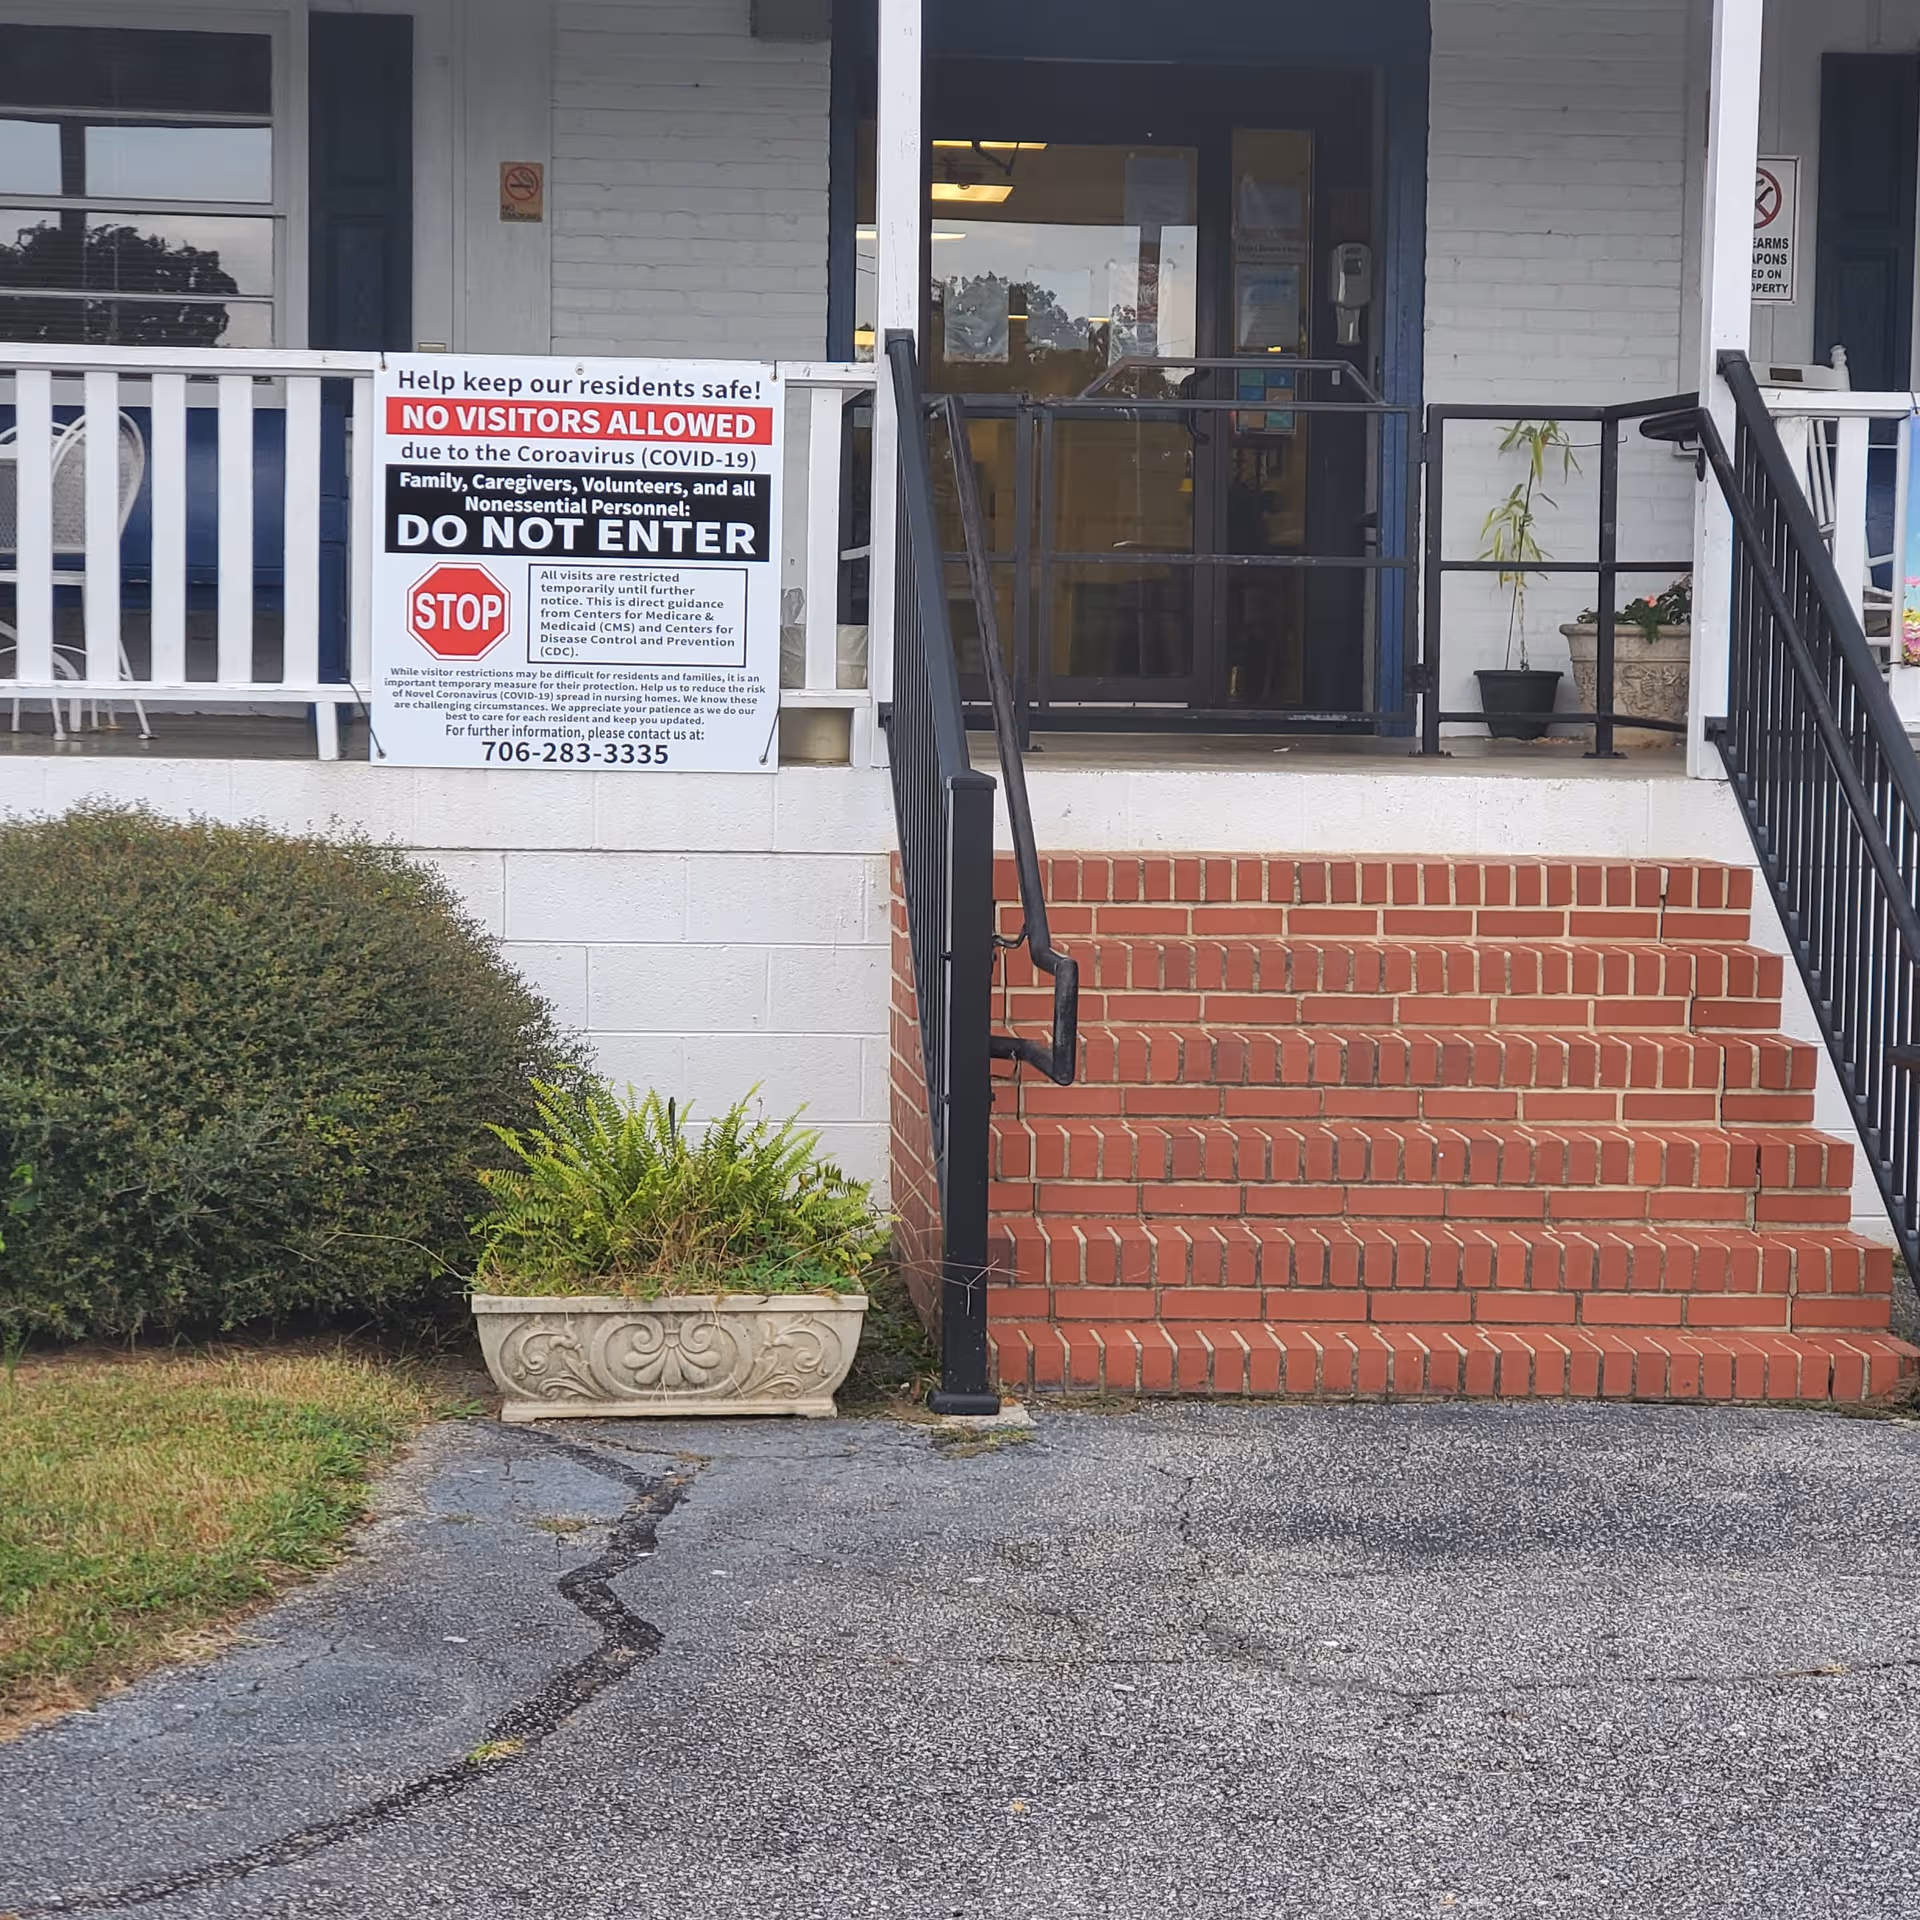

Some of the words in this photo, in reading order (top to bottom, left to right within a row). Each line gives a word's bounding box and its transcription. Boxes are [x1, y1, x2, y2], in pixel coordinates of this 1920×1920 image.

[1767, 270, 1781, 279] ON
[399, 370, 455, 393] Help
[464, 371, 522, 395] keep
[530, 378, 573, 393] our
[578, 373, 695, 397] residents
[702, 379, 760, 400] safe!
[402, 405, 449, 429] NO
[455, 406, 600, 433] VISITORS
[606, 410, 755, 438] ALLOWED
[401, 441, 441, 459] due
[447, 444, 469, 460] to
[475, 443, 510, 461] the
[517, 445, 634, 464] Coroavirus
[641, 447, 756, 472] (COVID-19)
[400, 472, 468, 492] Family,
[472, 474, 578, 495] Caregivers,
[581, 476, 688, 497] Volunteers,
[692, 479, 727, 495] and
[732, 480, 755, 496] all
[465, 496, 588, 514] Nonessential
[591, 499, 690, 516] Personnel:
[398, 514, 467, 547] DO
[482, 516, 584, 549] NOT
[598, 519, 756, 554] ENTER
[540, 570, 557, 579] All
[559, 570, 593, 580] visits
[619, 572, 679, 582] restricted
[541, 584, 615, 595] temporarily
[618, 584, 647, 594] until
[650, 585, 695, 595] further
[541, 596, 582, 606] notice.
[586, 596, 612, 606] This
[615, 596, 625, 606] is
[628, 597, 664, 607] direct
[667, 598, 724, 609] guidance
[415, 592, 502, 630] STOP
[540, 608, 570, 617] from
[573, 609, 621, 619] Centers
[624, 610, 643, 619] for
[646, 610, 702, 620] Medicare
[704, 612, 714, 620] &
[540, 621, 596, 631] Medicaid
[599, 622, 635, 633] (CMS)
[638, 623, 661, 632] and
[665, 624, 712, 633] Centers
[716, 624, 734, 634] for
[540, 634, 587, 643] Disease
[590, 635, 637, 644] Control
[640, 636, 663, 645] and
[667, 637, 735, 646] Prevention
[540, 646, 578, 658] (CDC).
[421, 668, 453, 676] visitor
[456, 668, 513, 677] restrictions
[516, 671, 537, 679] may
[540, 670, 552, 678] be
[554, 670, 594, 679] difficult
[596, 671, 611, 679] for
[612, 672, 659, 680] residents
[682, 672, 725, 683] families,
[727, 673, 735, 681] it
[737, 673, 745, 682] is
[384, 678, 436, 689] important
[438, 680, 492, 690] temporary
[540, 680, 554, 689] for
[556, 681, 581, 689] their
[582, 682, 638, 691] protection.
[640, 683, 663, 693] Help
[692, 684, 726, 692] reduce
[728, 684, 744, 693] the
[746, 684, 766, 693] risk
[436, 690, 498, 700] Coronavirus
[500, 691, 554, 701] (COVID-19)
[556, 692, 590, 702] spread
[592, 692, 602, 700] in
[604, 693, 642, 703] nursing
[644, 694, 680, 702] homes.
[700, 695, 728, 703] know
[730, 695, 758, 704] these
[412, 701, 472, 712] challenging
[473, 702, 548, 712] circumstances.
[551, 703, 566, 712] We
[568, 704, 621, 714] appreciate
[649, 704, 691, 714] patience
[723, 706, 736, 714] do
[445, 712, 467, 720] best
[505, 712, 521, 721] for
[522, 713, 546, 721] each
[548, 713, 590, 722] resident
[591, 714, 610, 722] and
[613, 715, 637, 725] keep
[660, 716, 704, 725] updated.
[446, 724, 465, 735] For
[467, 724, 509, 736] further
[512, 725, 585, 740] information,
[588, 726, 625, 741] please
[627, 728, 670, 739] contact
[673, 731, 686, 740] us
[689, 729, 704, 740] at:
[482, 741, 668, 764] 706-283-3335
